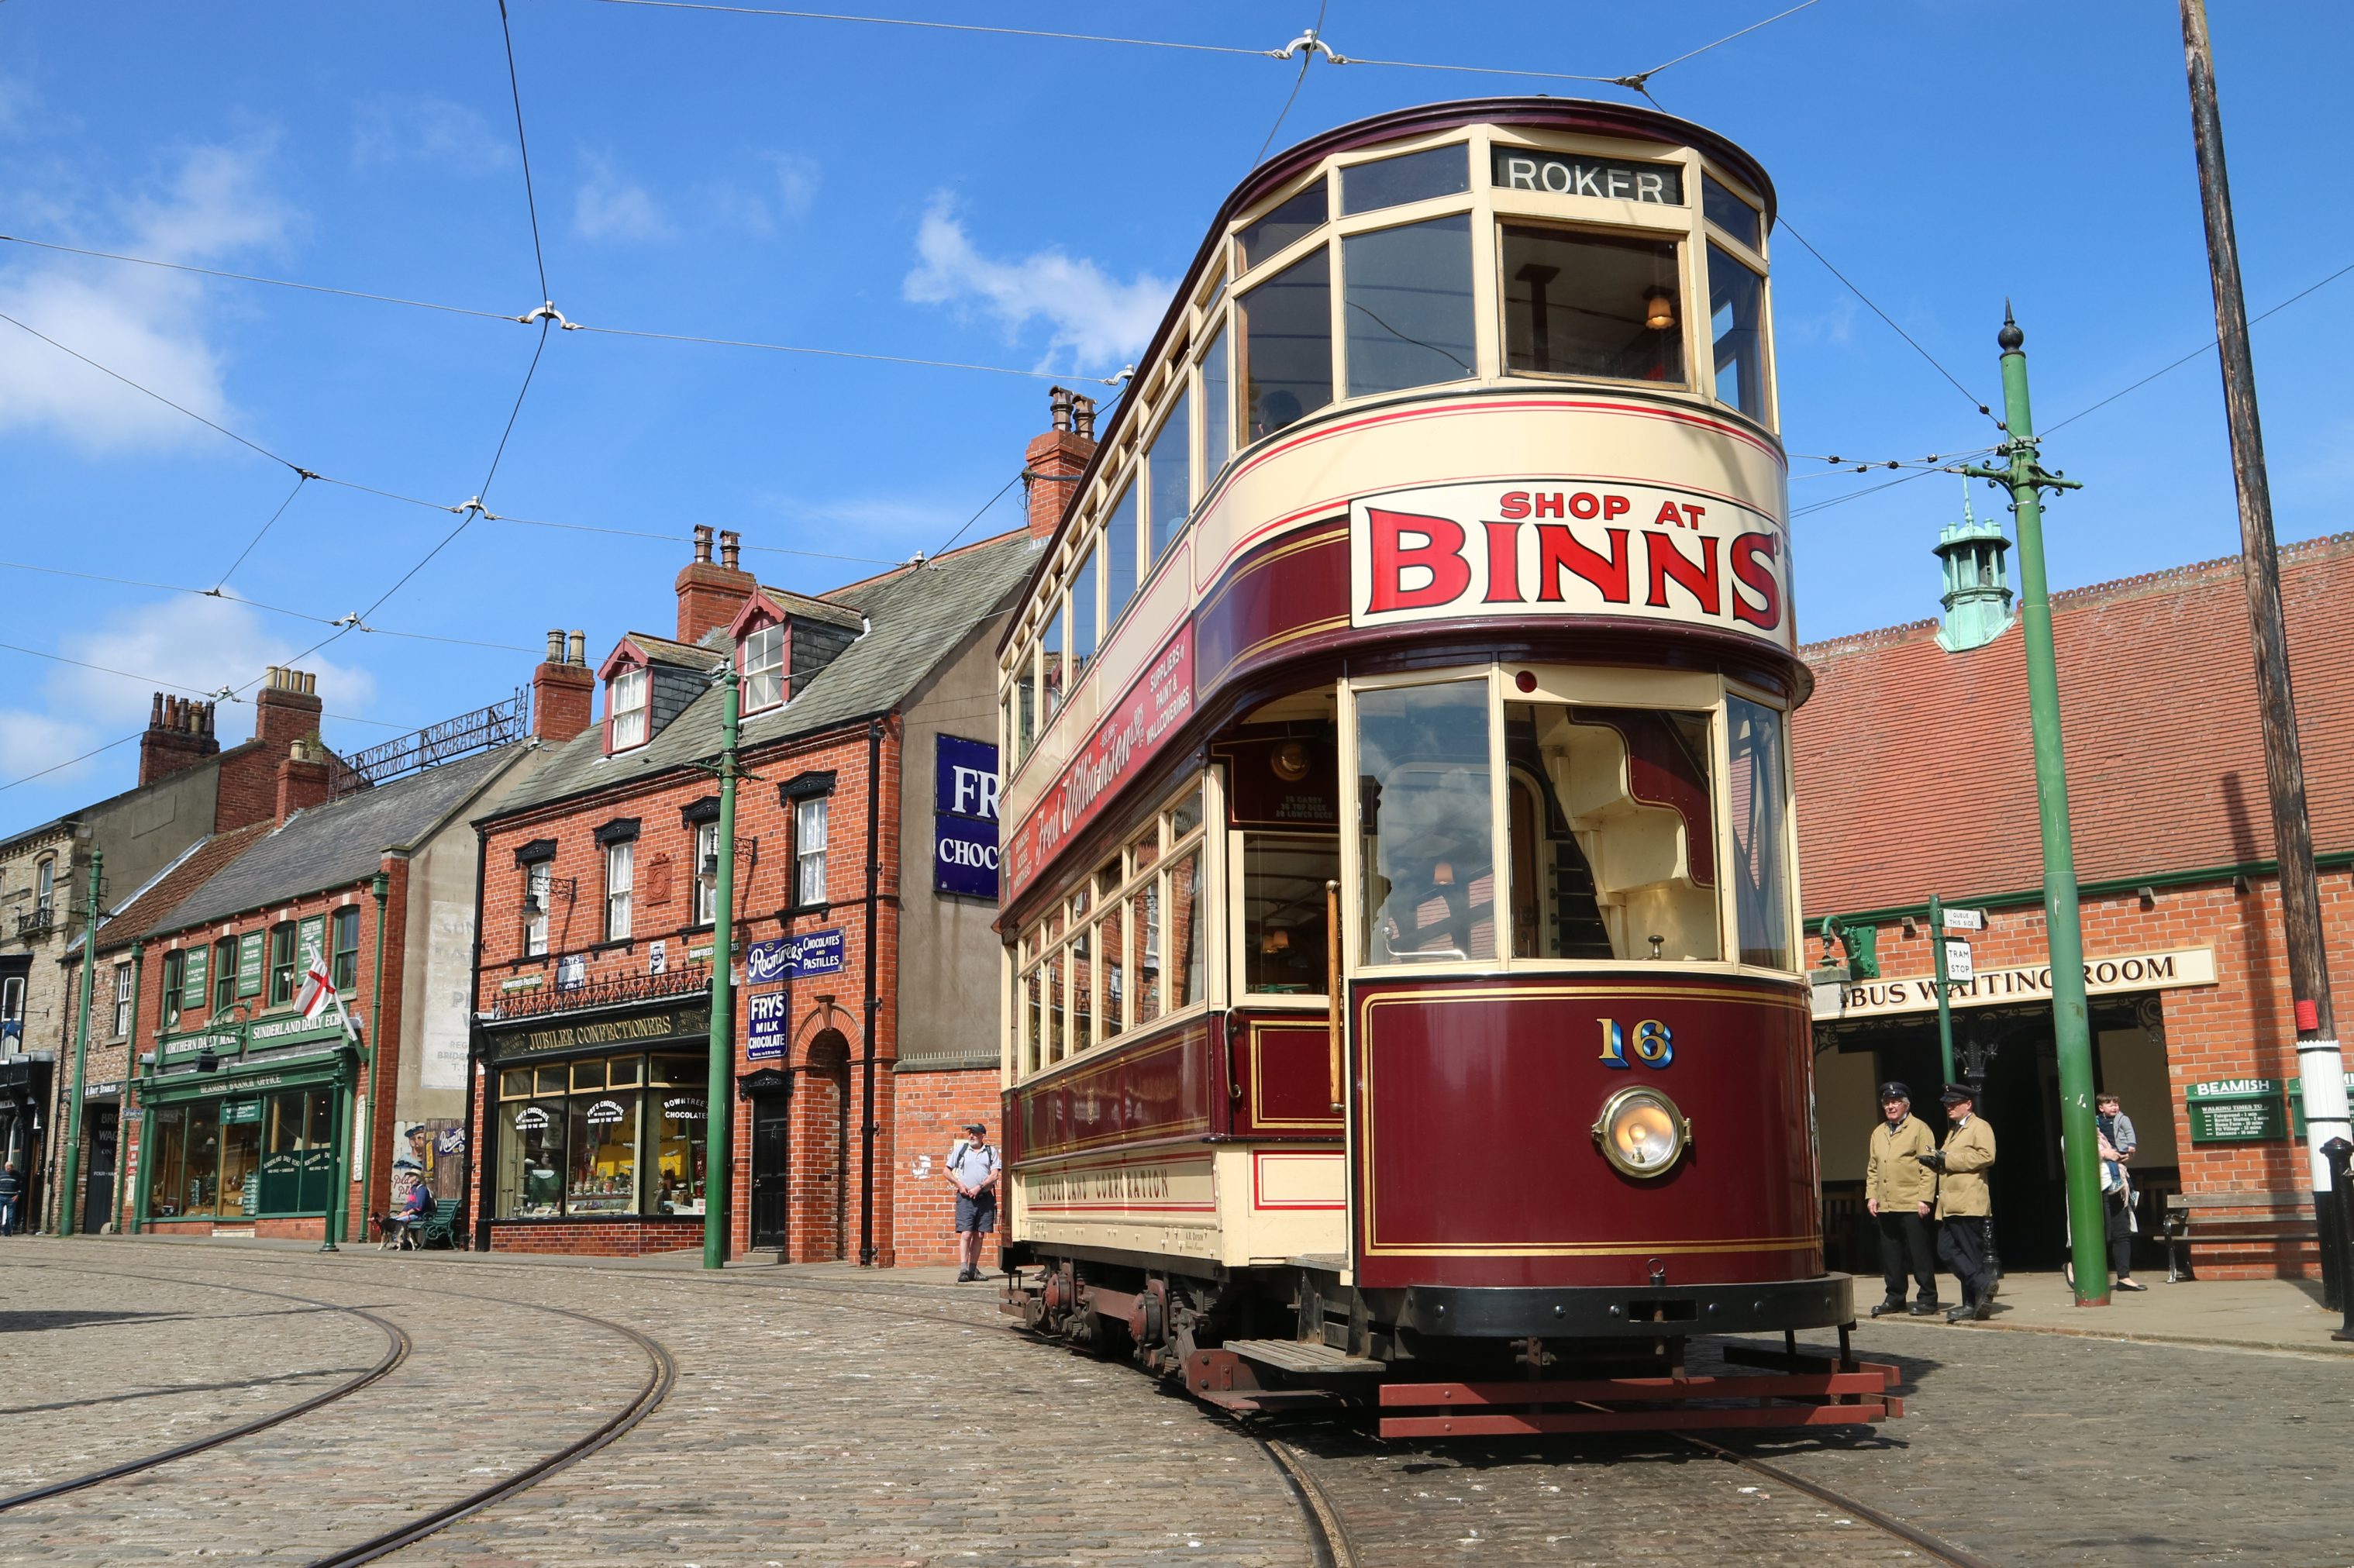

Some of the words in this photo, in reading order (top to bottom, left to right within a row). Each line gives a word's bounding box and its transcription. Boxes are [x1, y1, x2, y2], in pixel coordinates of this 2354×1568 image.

[1508, 157, 1664, 204] ROKER
[1500, 491, 1631, 520] SHOP
[1655, 501, 1705, 530] AT
[1150, 644, 1180, 693] SUPPLIERS
[1156, 679, 1172, 712] PAINT
[1173, 674, 1177, 693] &
[1146, 685, 1190, 746] WALLCOVERINGS
[1036, 792, 1061, 866] Fred
[1063, 725, 1131, 834] Williamson
[1287, 810, 1312, 818] LOWER
[749, 943, 803, 978] Rowntree's
[803, 935, 840, 949] CHOCOLATES
[803, 955, 839, 970] PASTILLES
[751, 994, 785, 1021] FRY'S
[1851, 984, 1907, 1008] BUS
[253, 1020, 300, 1040] SUNDERLAND
[302, 1016, 324, 1032] DAILY
[529, 1029, 575, 1051] JUBILEE
[577, 1015, 672, 1045] CONFECTIONERS
[756, 1021, 779, 1034] MILK
[164, 1039, 198, 1055] NORTHERN
[749, 1034, 785, 1049] CHOCOLATE
[1596, 1018, 1673, 1068] 16
[100, 1085, 116, 1094] STABLES
[200, 1081, 227, 1094] BEAMISH
[229, 1078, 255, 1090] BRANCH
[257, 1074, 282, 1086] OFFICE
[2197, 1080, 2270, 1096] BEAMISH
[527, 1107, 550, 1122] CHOCOLATE
[600, 1100, 624, 1116] CHOCOLATE
[264, 1155, 282, 1170] SUNDERLAND
[283, 1155, 291, 1163] DAILY
[291, 1159, 300, 1167] ECHO
[304, 1153, 321, 1167] NORTHERN
[1039, 1174, 1087, 1201] SUNDERLAND
[1095, 1168, 1169, 1199] CORPORATION
